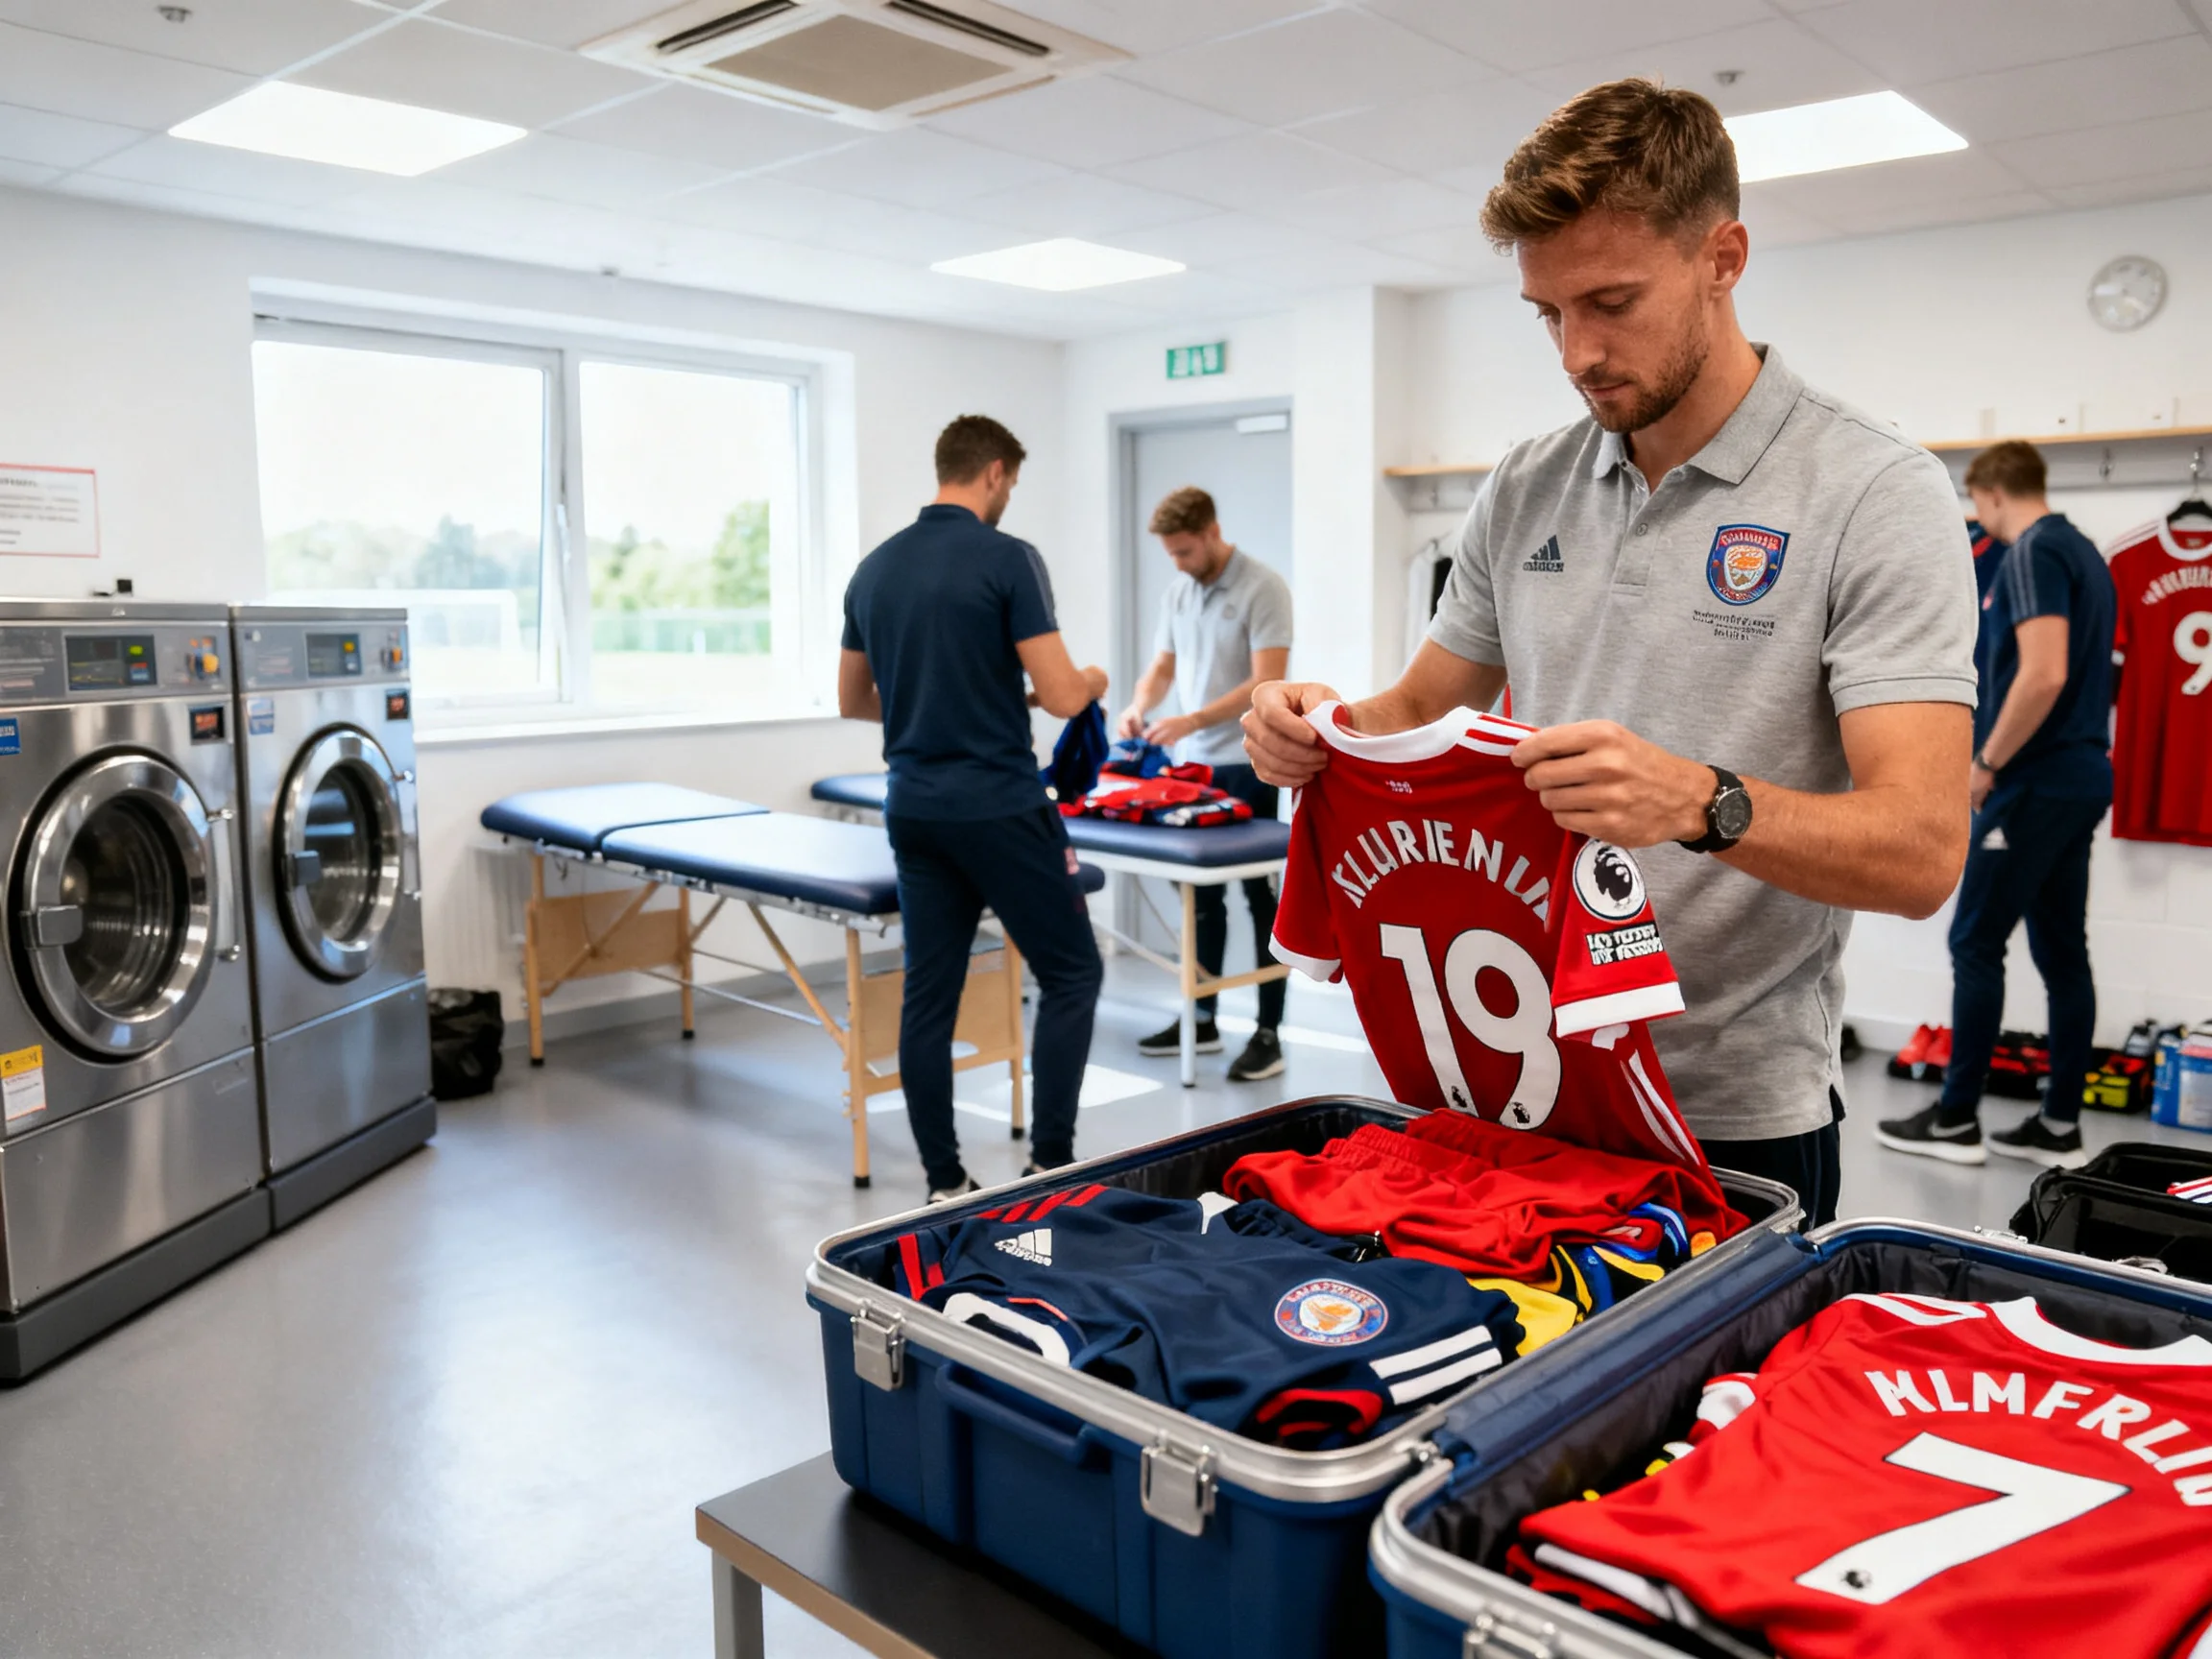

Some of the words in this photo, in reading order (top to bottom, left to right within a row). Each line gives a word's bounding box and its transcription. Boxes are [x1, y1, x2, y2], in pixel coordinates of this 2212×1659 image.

[2173, 611, 2212, 695] 9
[1379, 923, 1562, 1131] 19
[1793, 1431, 2133, 1605] 7
